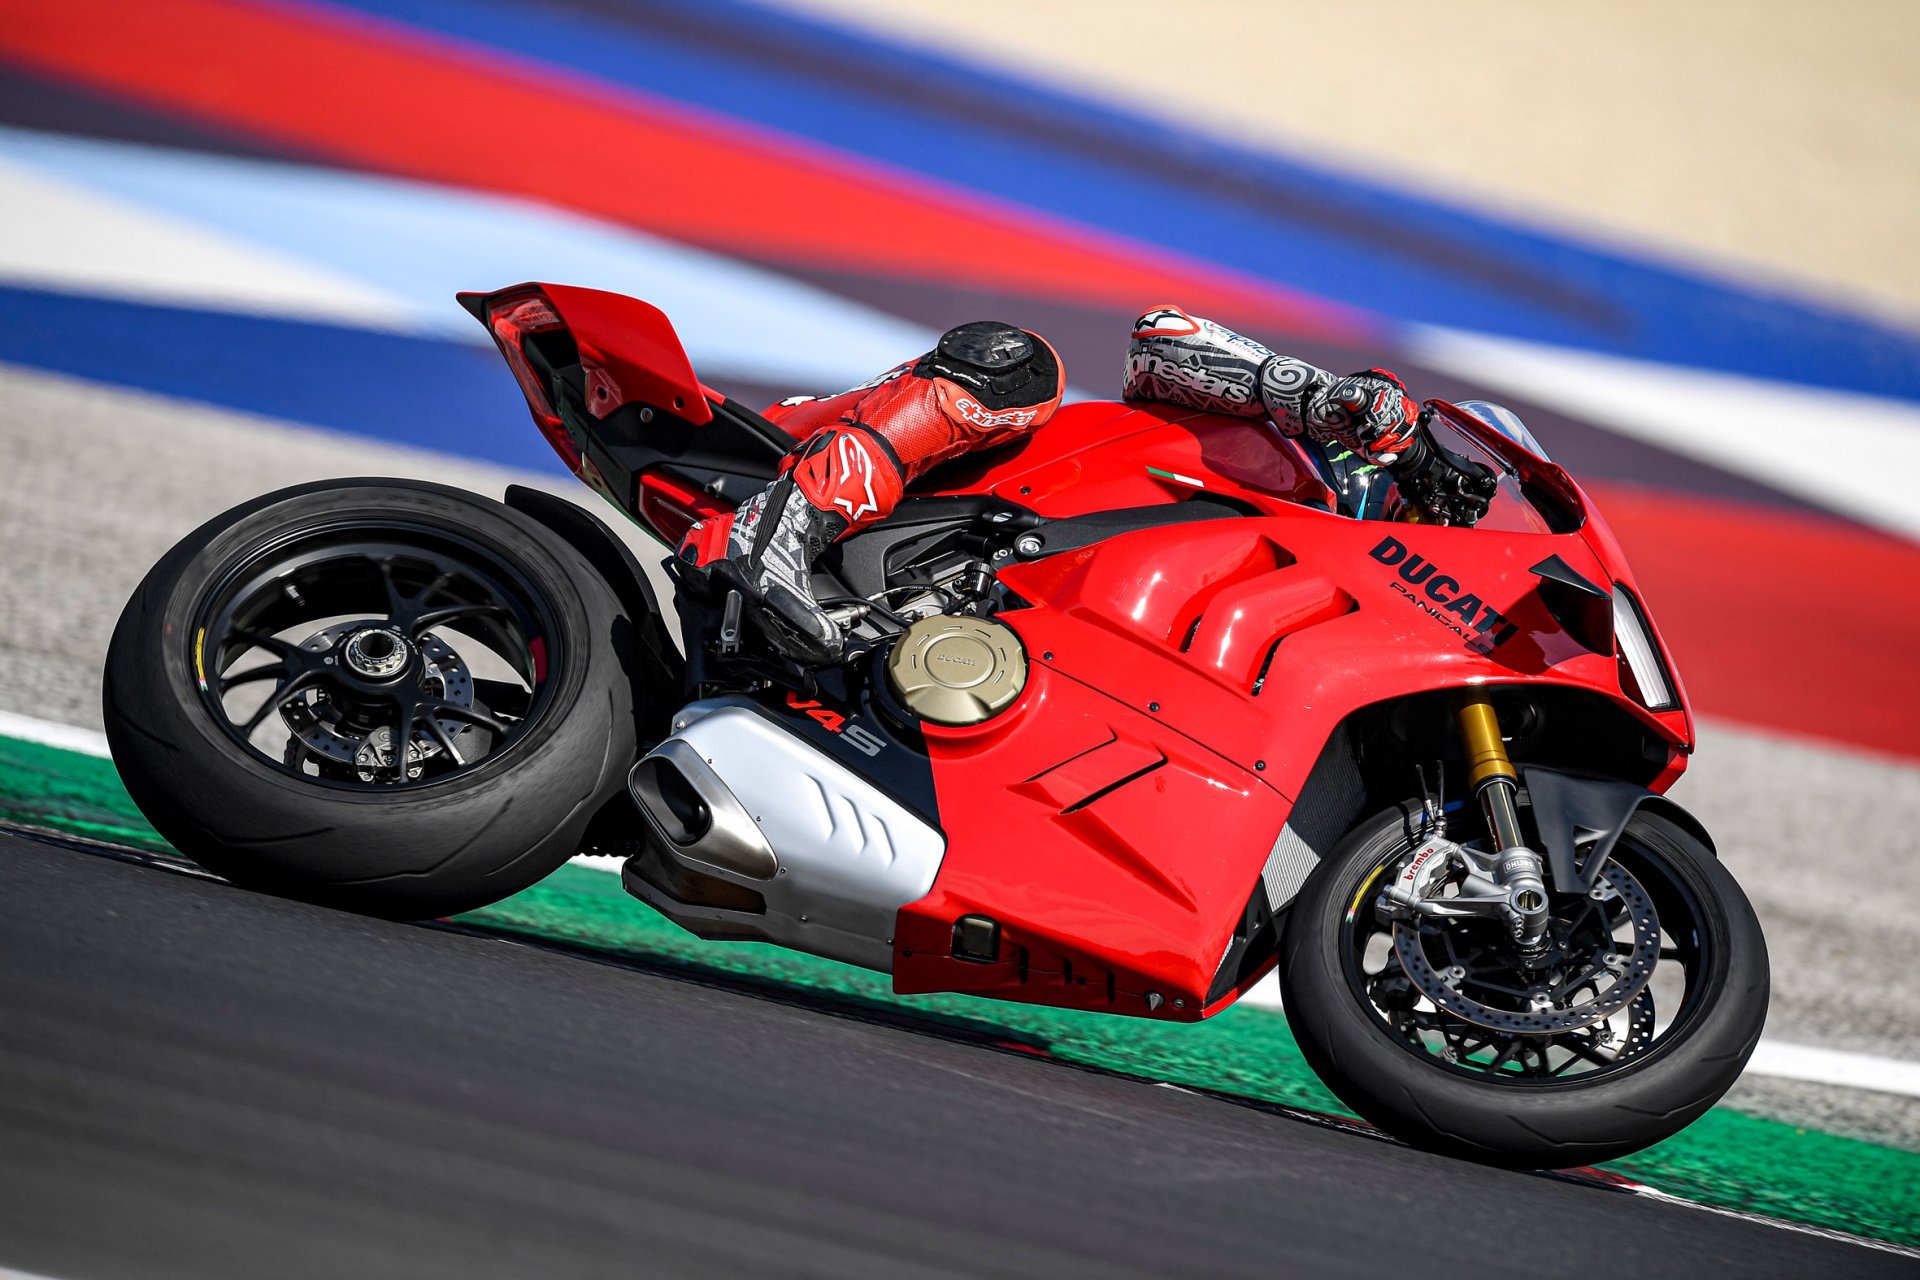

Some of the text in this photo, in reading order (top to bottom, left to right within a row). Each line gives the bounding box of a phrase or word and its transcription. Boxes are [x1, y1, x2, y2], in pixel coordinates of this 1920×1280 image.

[1368, 535, 1520, 648] DUCATI
[937, 653, 977, 667] DUCATI
[1403, 848, 1434, 881] brembo
